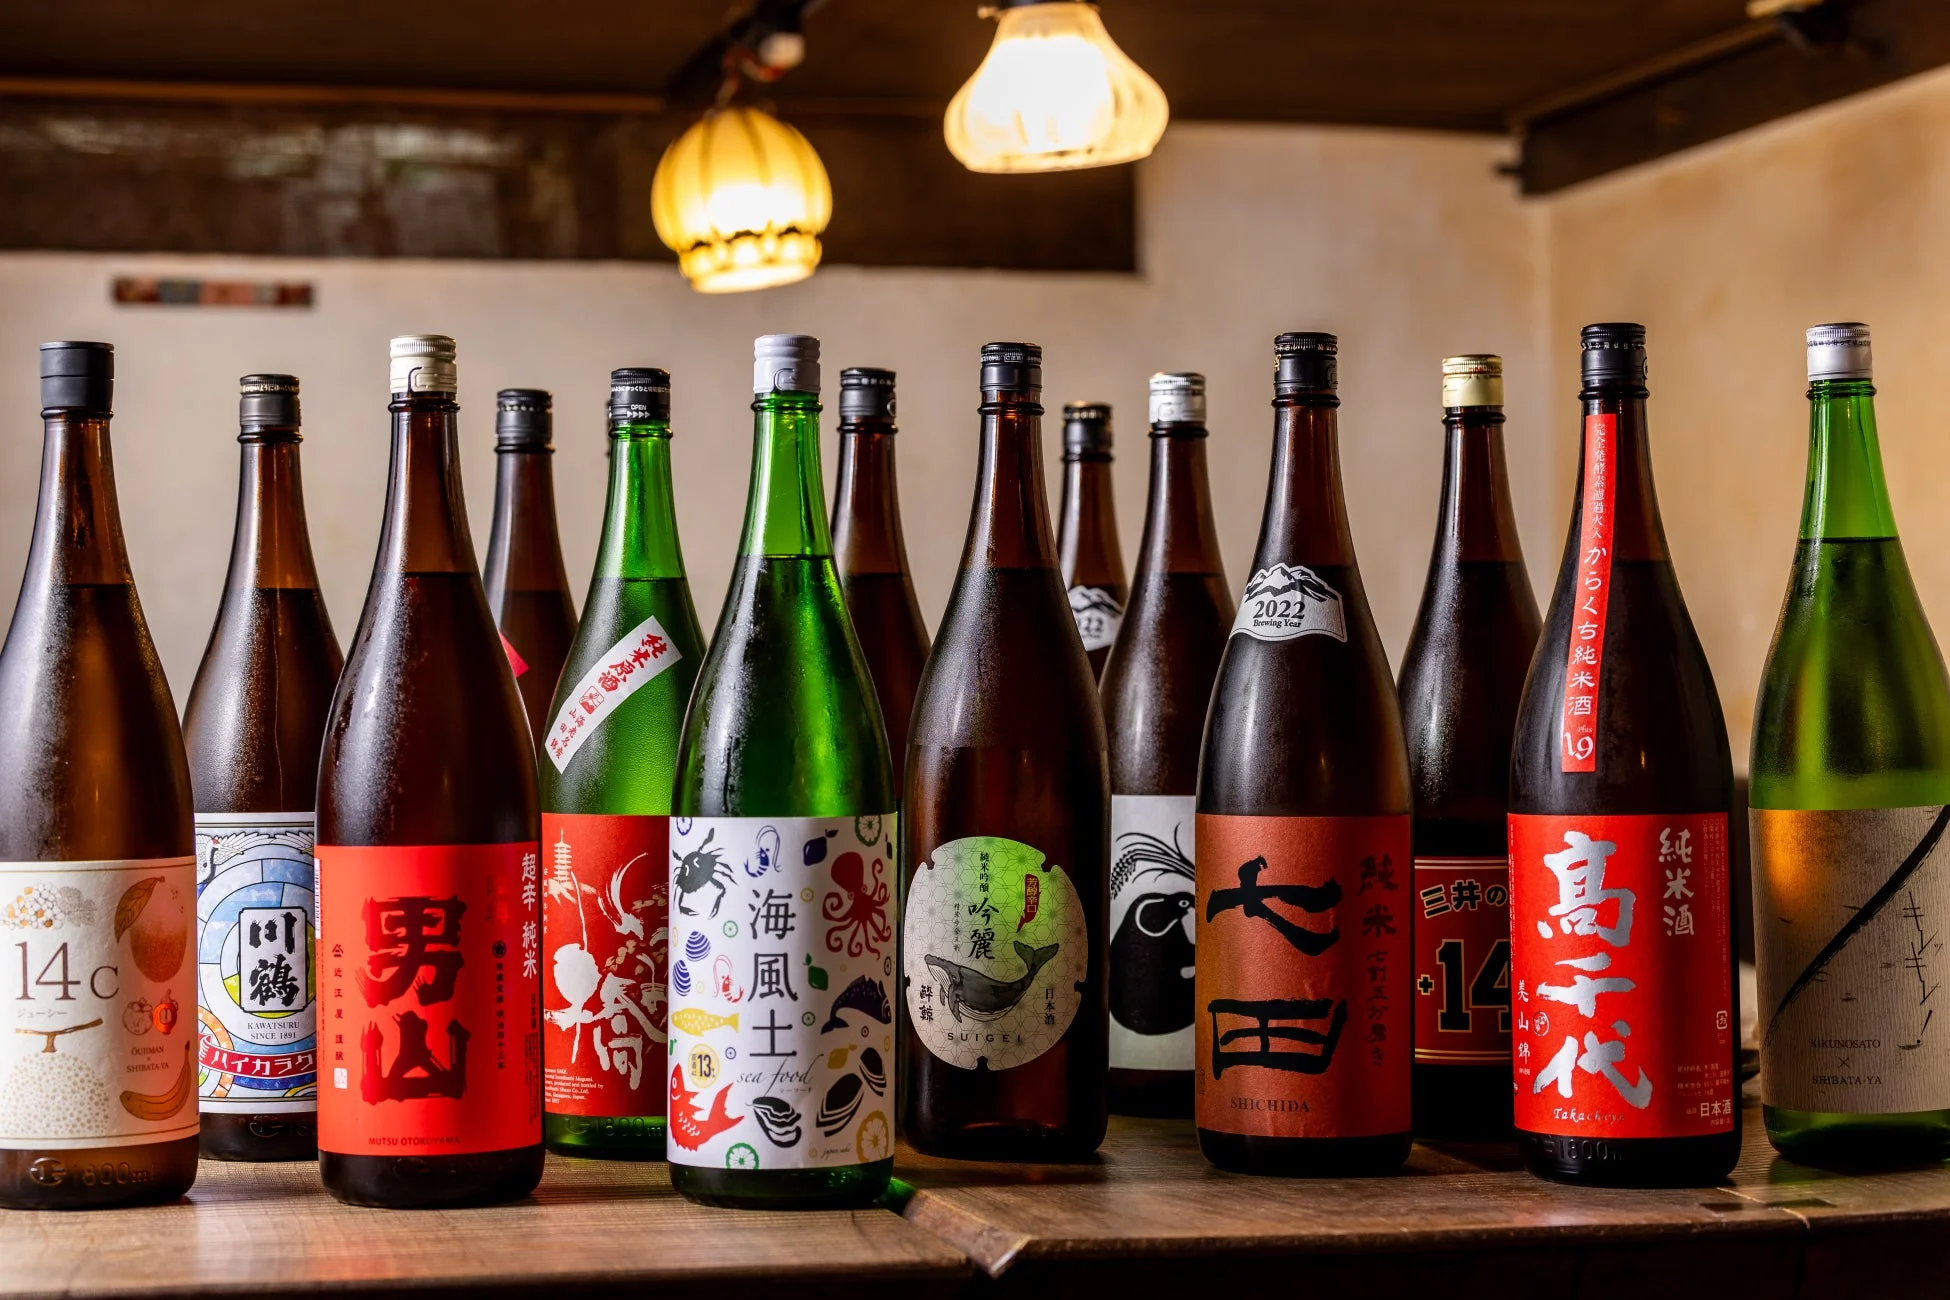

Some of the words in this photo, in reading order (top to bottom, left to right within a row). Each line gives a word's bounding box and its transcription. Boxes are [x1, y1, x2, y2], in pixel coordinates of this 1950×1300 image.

[1253, 600, 1306, 620] 2022
[1253, 619, 1282, 629] Brewing
[1283, 618, 1302, 629] Year
[1568, 546, 1607, 716] からくち純米酒
[598, 633, 668, 693] 純米原酒
[1564, 731, 1594, 761] 19
[1577, 724, 1593, 733] Plus
[522, 853, 537, 911] 超辛
[979, 851, 990, 894] 純米吟醸
[1657, 827, 1695, 937] 純米酒
[1357, 853, 1400, 938] 純米
[1419, 878, 1508, 919] 三井の
[968, 896, 999, 960] 吟麗
[249, 911, 300, 1007] 川鶴
[522, 920, 538, 979] 純米
[1206, 855, 1348, 1081] 七田
[747, 888, 799, 1057] 海風土
[17, 1008, 68, 1019] ジューシー
[355, 896, 471, 1106] 男山
[919, 984, 934, 1022] 酔鯨
[1044, 987, 1055, 1025] 日本酒
[1365, 951, 1389, 1067] 七割五分磨き
[247, 1021, 300, 1030] KAWATSURU
[250, 1032, 278, 1041] SINCE
[279, 1032, 297, 1041] 1891
[947, 1032, 1021, 1043] SUIGEI
[1517, 979, 1530, 1065] 美山錦
[211, 1049, 313, 1076] ハイカラク
[1809, 1039, 1881, 1050] KIKUNOSATO
[697, 1054, 712, 1078] 13
[738, 1072, 767, 1085] sea
[762, 1054, 823, 1099] food
[1230, 1097, 1310, 1113] SHICHIDA
[1700, 1098, 1731, 1118] 日本酒
[368, 1137, 399, 1146] MUTSU
[400, 1136, 461, 1146] OTOKOYAMA
